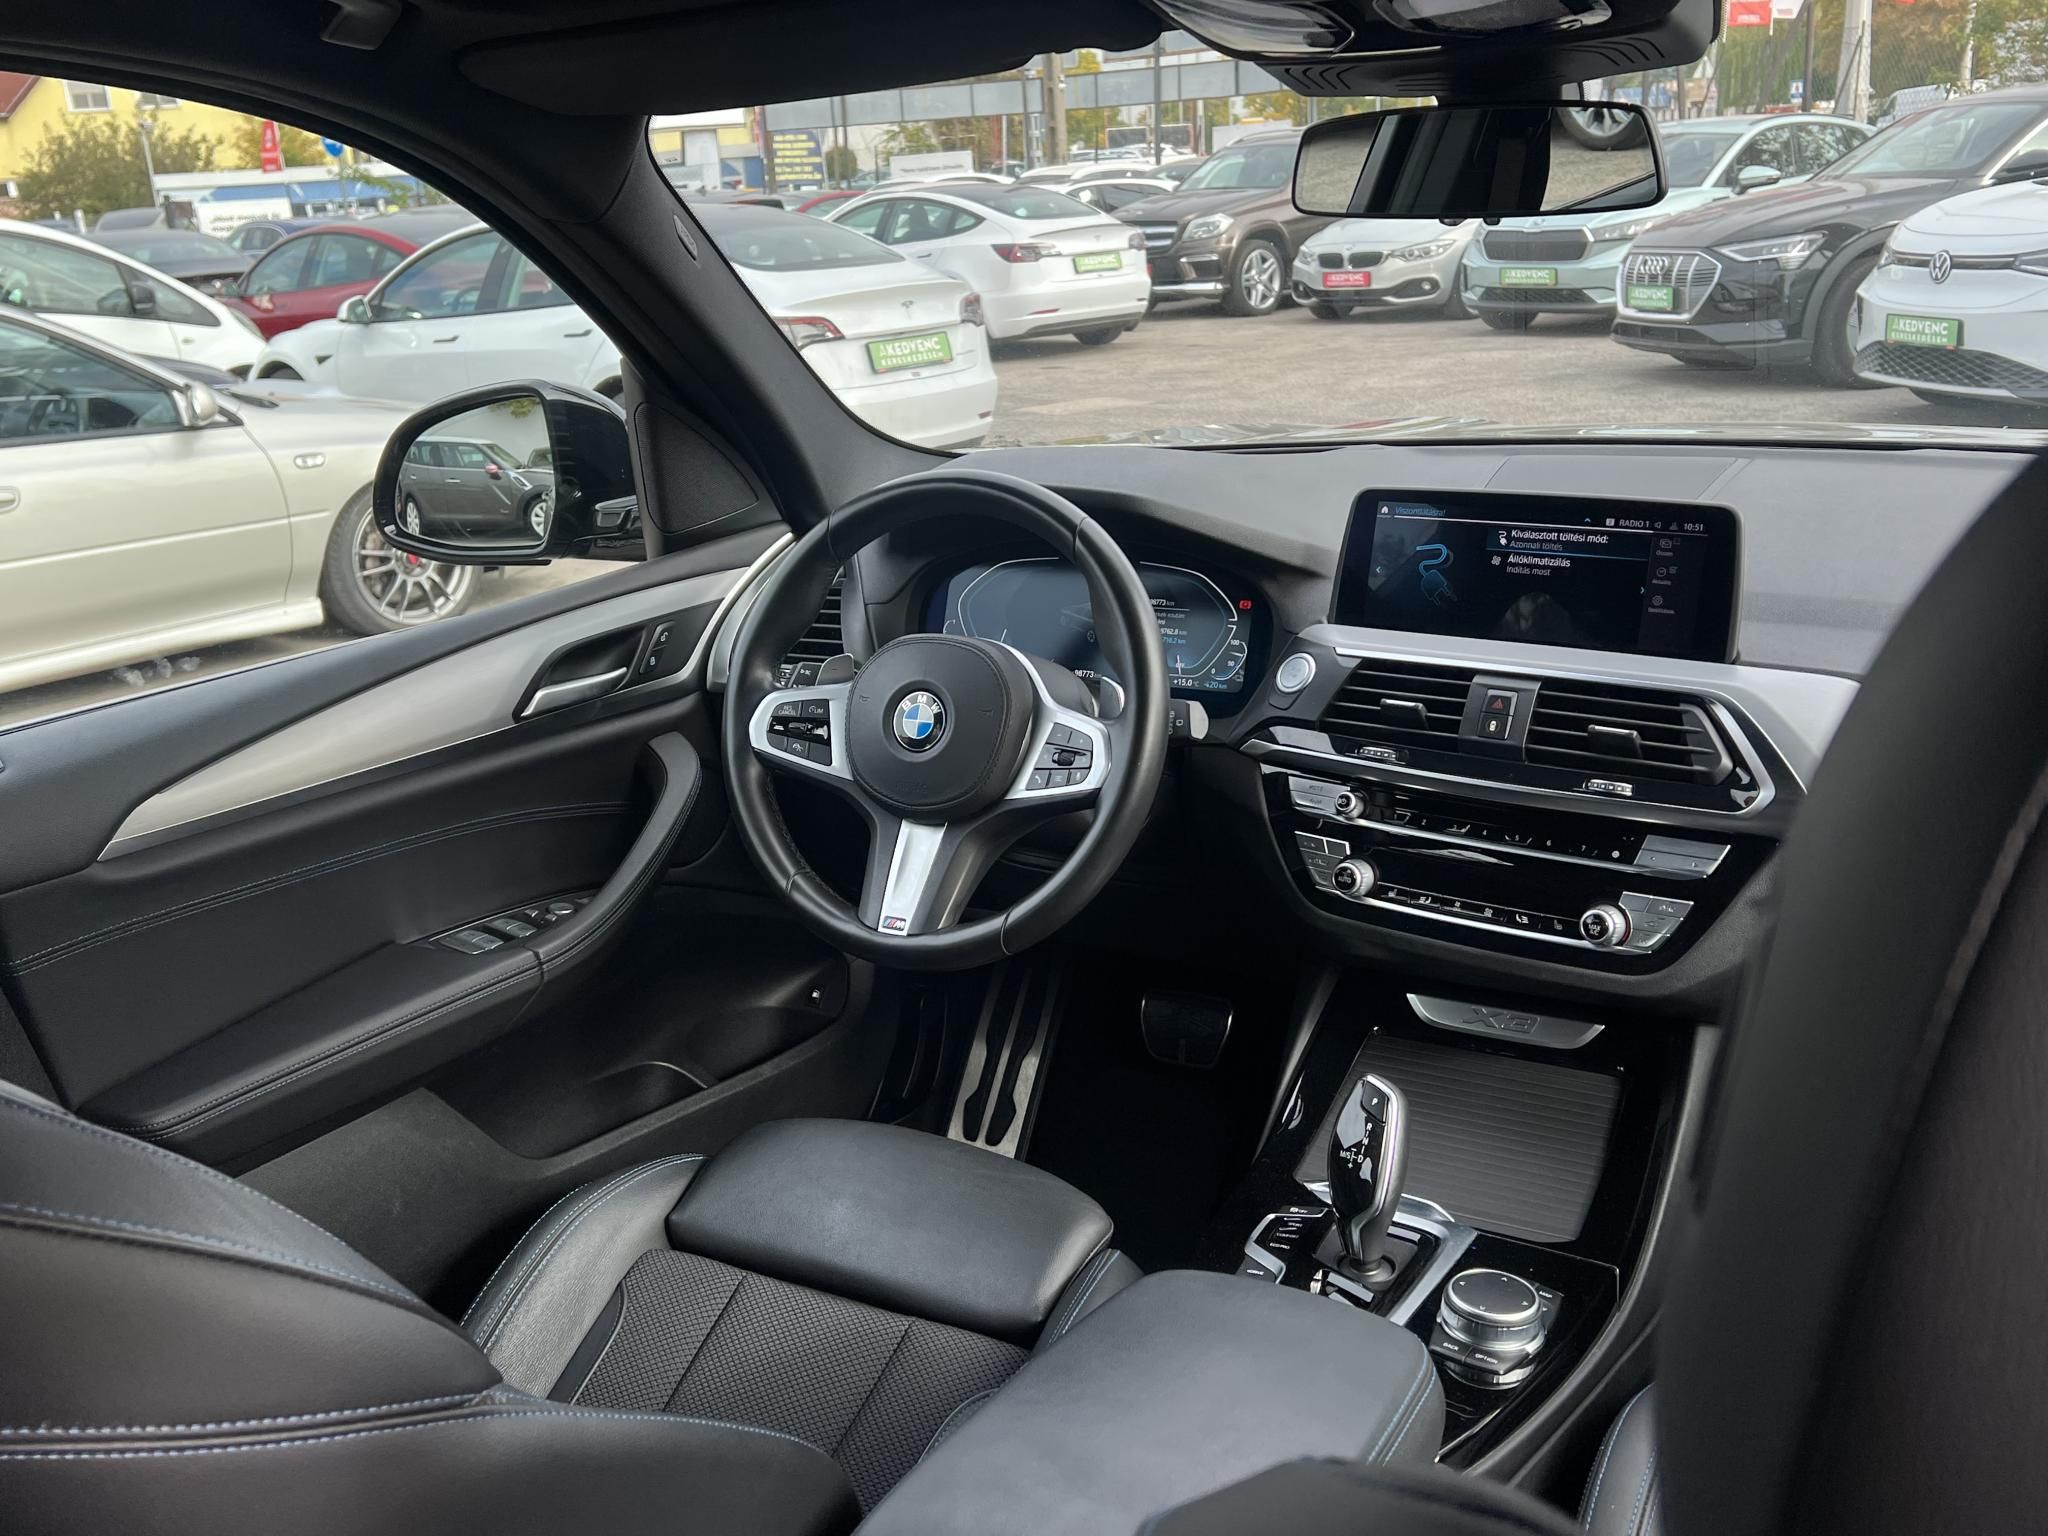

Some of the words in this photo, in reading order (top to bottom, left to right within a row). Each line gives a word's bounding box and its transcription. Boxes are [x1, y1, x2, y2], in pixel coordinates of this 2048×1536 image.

[1619, 519, 1644, 528] RADIO
[1684, 523, 1704, 531] 10:51
[1511, 529, 1558, 541] Kiválasztott
[1560, 532, 1586, 542] töltési
[1587, 534, 1609, 544] mód:
[1507, 553, 1571, 567] Állóklimatizálás
[1532, 568, 1551, 576] most
[1371, 1097, 1378, 1106] P
[1366, 1122, 1373, 1131] R
[1362, 1137, 1370, 1146] N
[1357, 1154, 1364, 1163] D
[1442, 1342, 1459, 1351] BACK
[1475, 1353, 1498, 1364] OPTION
